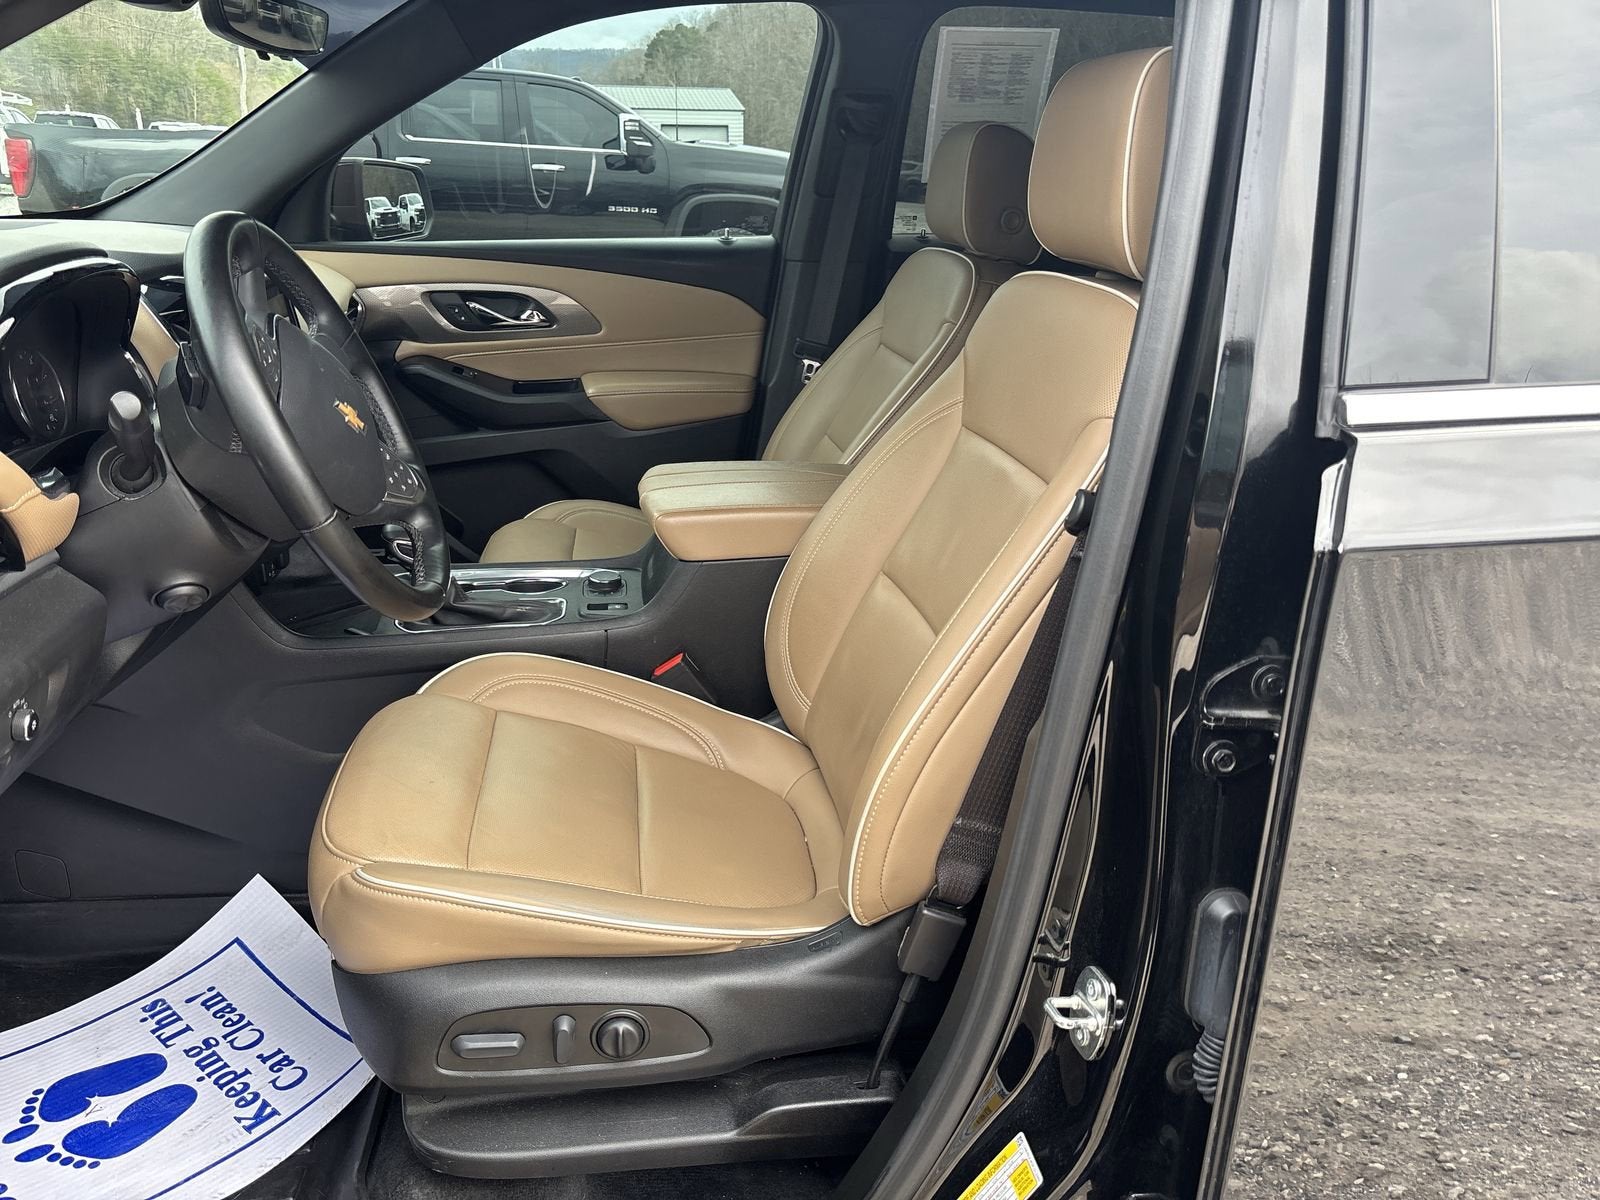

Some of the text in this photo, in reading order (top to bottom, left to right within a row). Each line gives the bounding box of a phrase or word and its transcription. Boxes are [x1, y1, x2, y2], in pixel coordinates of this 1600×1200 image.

[608, 205, 639, 213] 3500
[139, 998, 281, 1134] Keeping This
[184, 985, 308, 1091] Car Clean!
